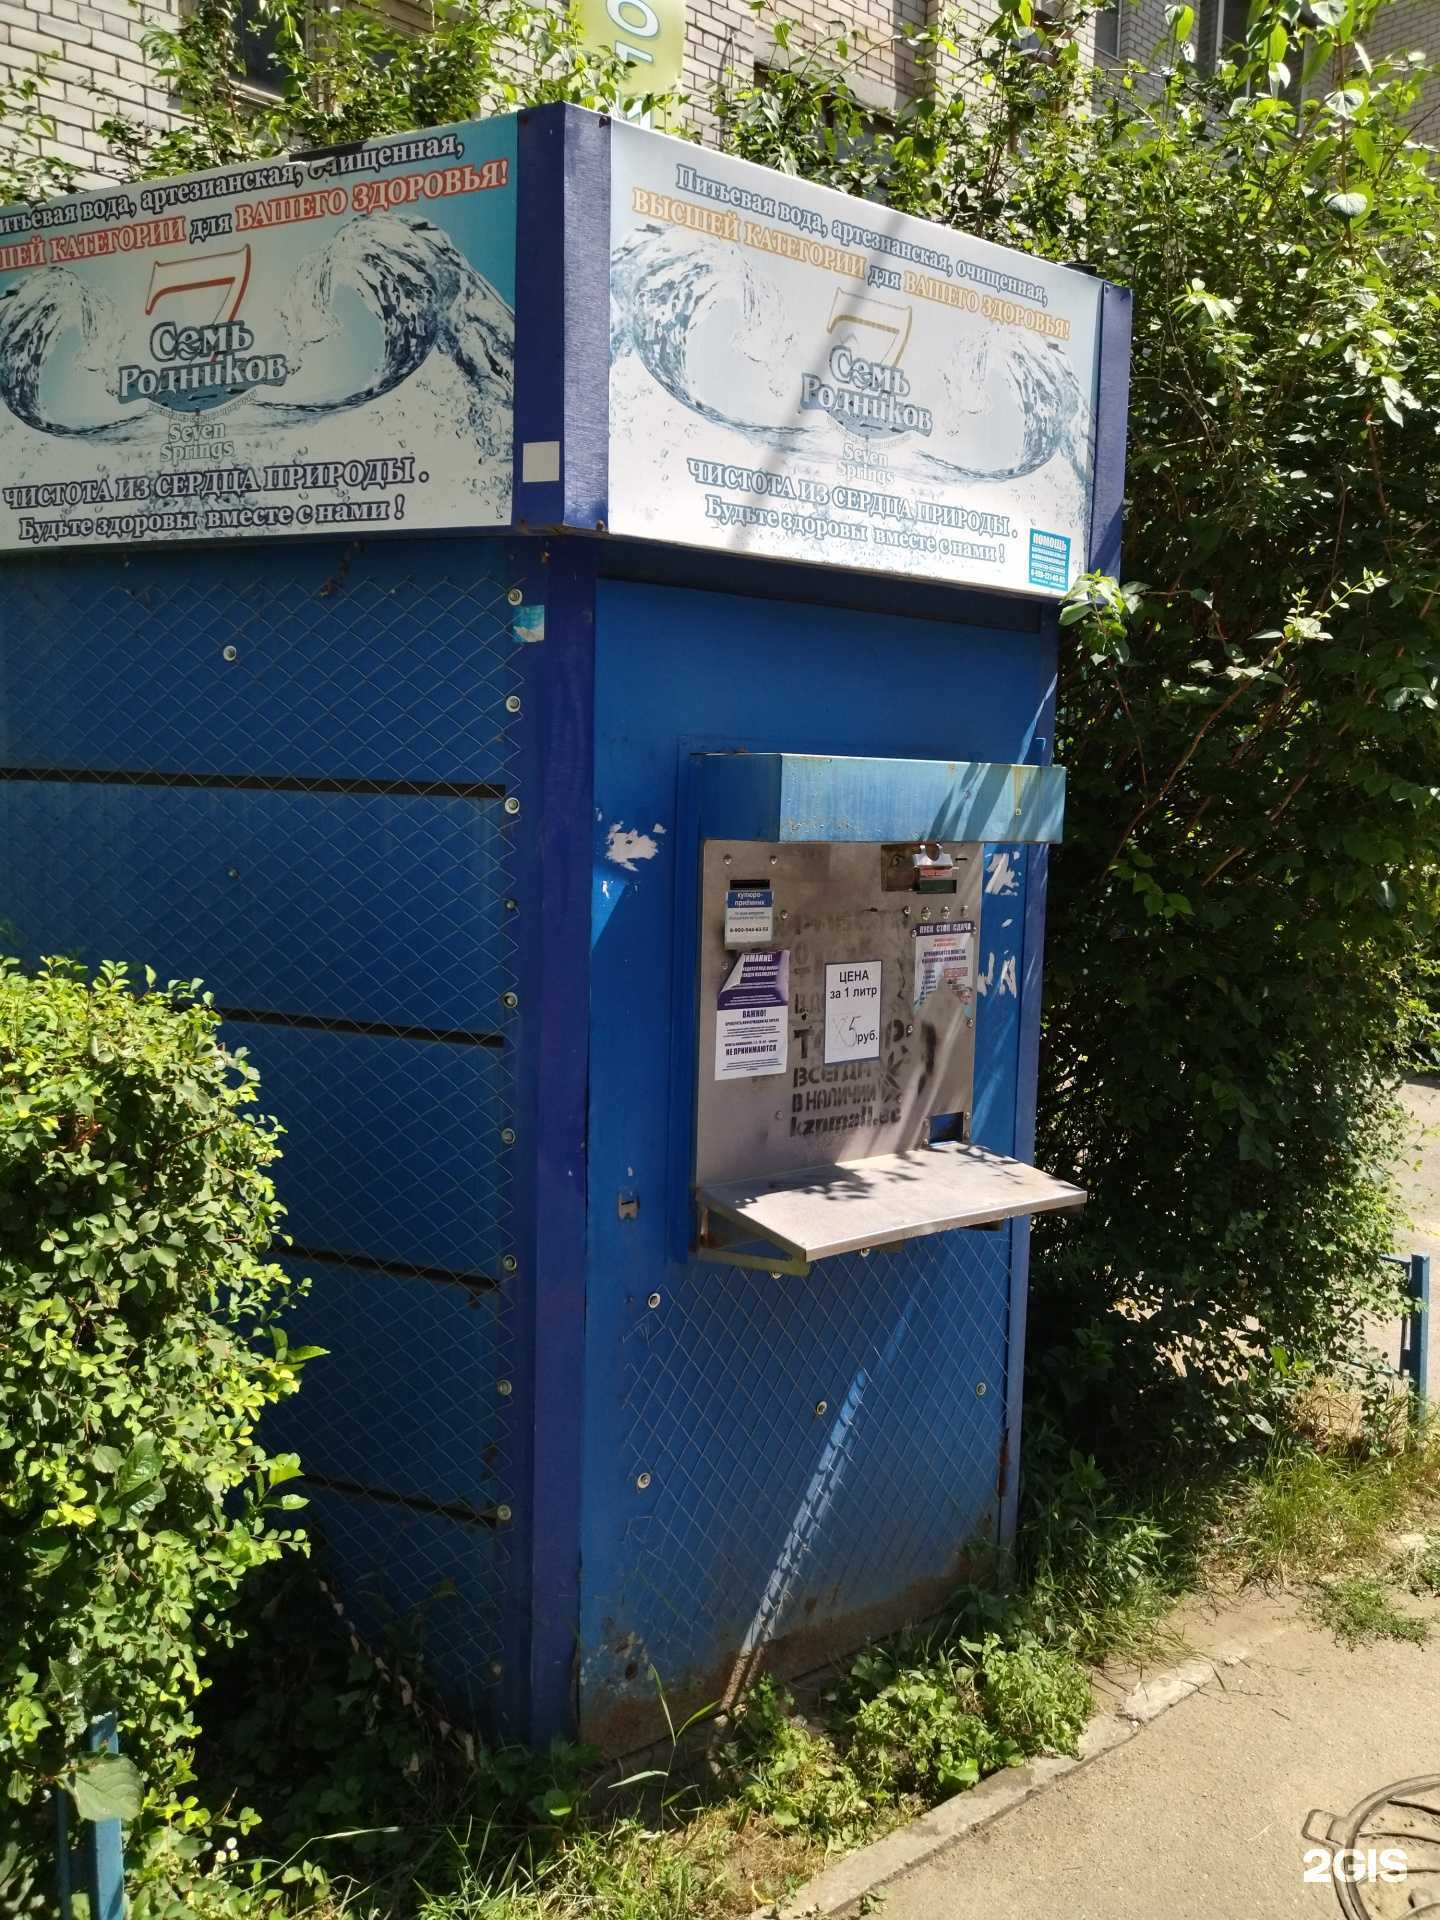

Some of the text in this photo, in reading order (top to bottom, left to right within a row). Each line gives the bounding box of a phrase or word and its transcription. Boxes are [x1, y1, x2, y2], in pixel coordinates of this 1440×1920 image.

[49, 216, 188, 263] КАТЕГОРИИ
[190, 211, 232, 244] для
[234, 187, 348, 231] ВАШЕГО
[352, 157, 509, 215] ЗДОРОВЬЯ!
[80, 193, 137, 222] вода,
[141, 163, 302, 214] артезианская,
[676, 163, 1048, 307] Питьевая вода, артезианская, очищенная,
[632, 186, 1071, 341] ВЫСШЕЙ КАТЕГОРИИ для ВАШЕГО ЗДОРОВЬЯ!
[150, 320, 254, 362] Семь
[829, 345, 910, 397] Семь
[168, 422, 226, 443] Seven
[160, 440, 235, 467] Springs
[843, 442, 888, 467] Seven
[3, 478, 115, 509] ЧИСТОТА
[115, 475, 151, 501] ИЗ
[154, 467, 260, 497] СЕРДЦА
[687, 457, 797, 498] ЧИСТОТА
[798, 479, 830, 505] ИЗ
[832, 486, 913, 521] СЕРДЦА
[837, 460, 895, 486] Springs
[19, 517, 93, 543] Будьте
[96, 511, 198, 539] здоровы
[206, 506, 293, 528] вместе
[296, 505, 313, 524] с
[705, 493, 780, 526] Будьте
[781, 510, 868, 540] здоровы
[874, 527, 936, 552] вместе
[939, 539, 950, 554] с
[936, 923, 951, 933] СТОП
[830, 986, 877, 999] за 1 литр
[839, 970, 869, 985] ЦЕНА
[742, 1009, 767, 1019] ВАЖНО!
[857, 1030, 879, 1046] руб.
